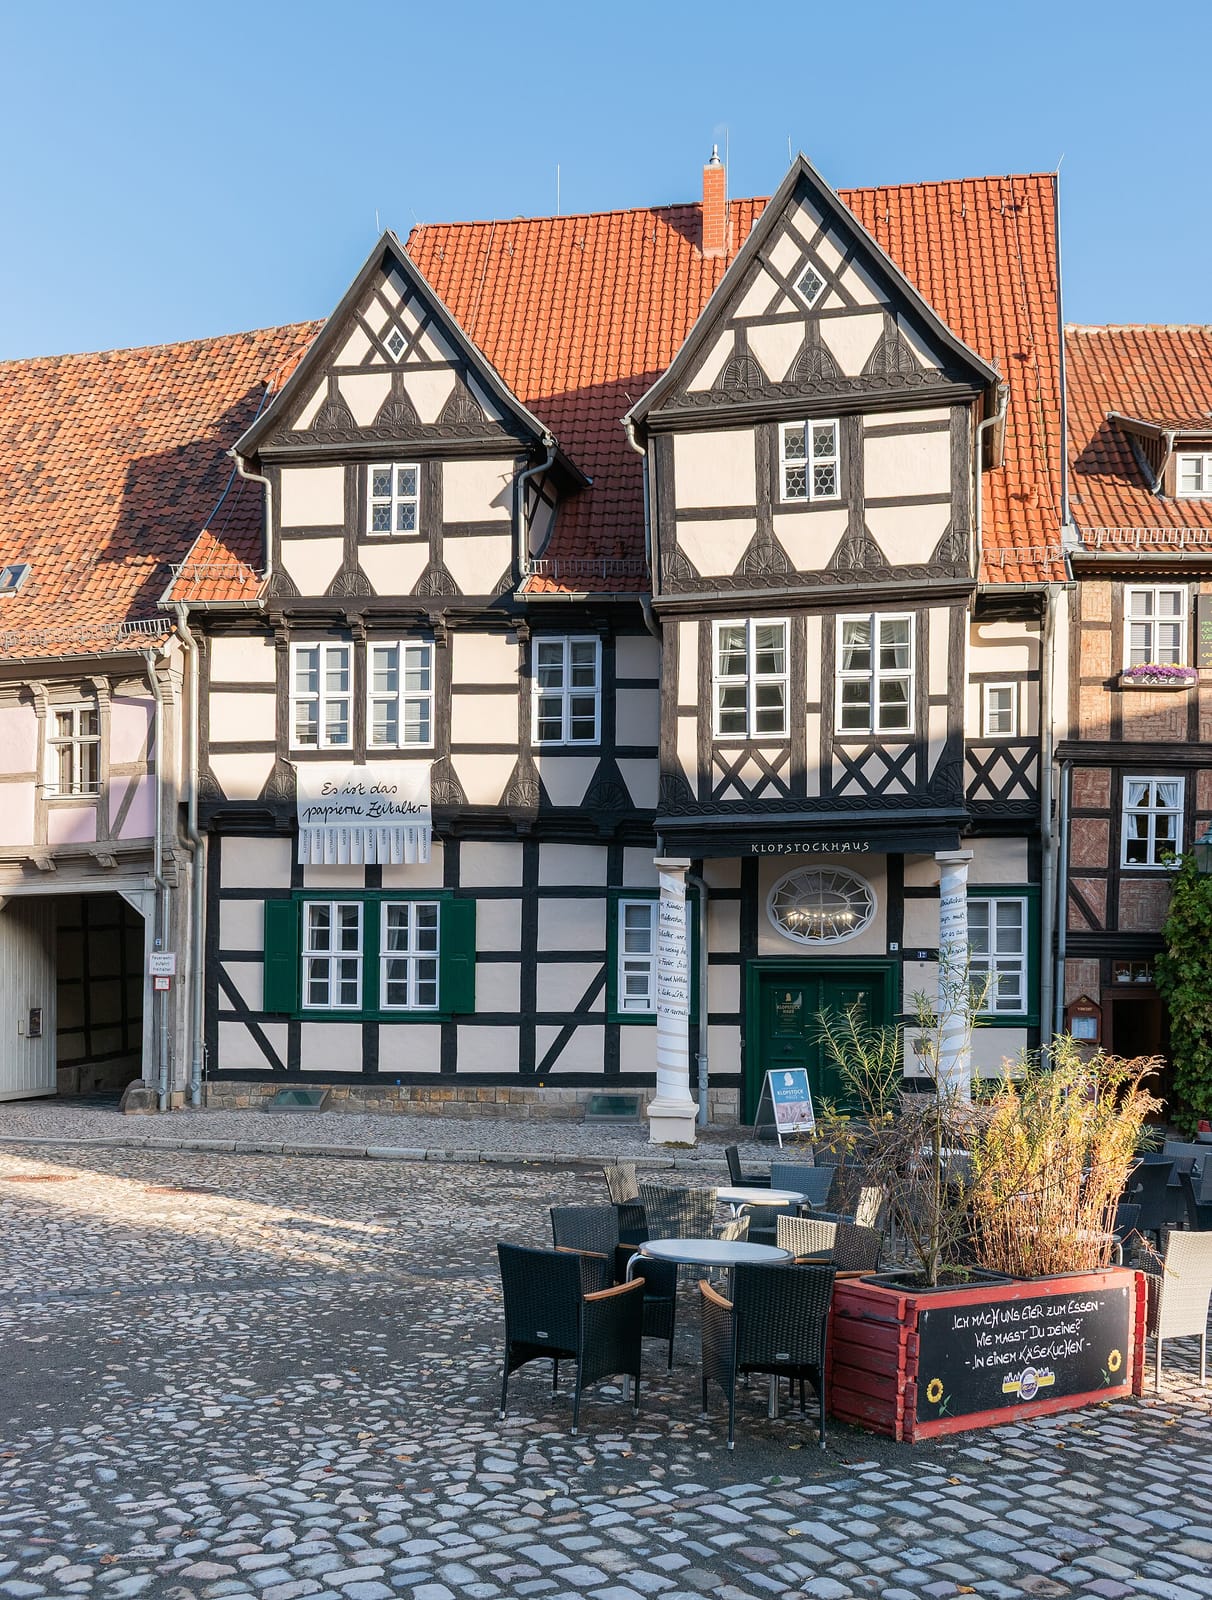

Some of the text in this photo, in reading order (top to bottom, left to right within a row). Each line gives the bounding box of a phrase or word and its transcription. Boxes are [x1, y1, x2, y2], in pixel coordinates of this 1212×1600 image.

[321, 781, 398, 796] Es ist das
[302, 800, 428, 824] papierne Zeitalter
[751, 841, 870, 855] KLOPSTOCKHAUS
[972, 1308, 999, 1328] MACH
[1000, 1308, 1020, 1323] UNS
[1021, 1304, 1044, 1320] EIER
[1046, 1304, 1066, 1317] ZUM
[974, 1332, 993, 1348] WIE
[995, 1329, 1028, 1344] MAGST
[1029, 1325, 1044, 1339] DU
[986, 1351, 1017, 1366] EINEM
